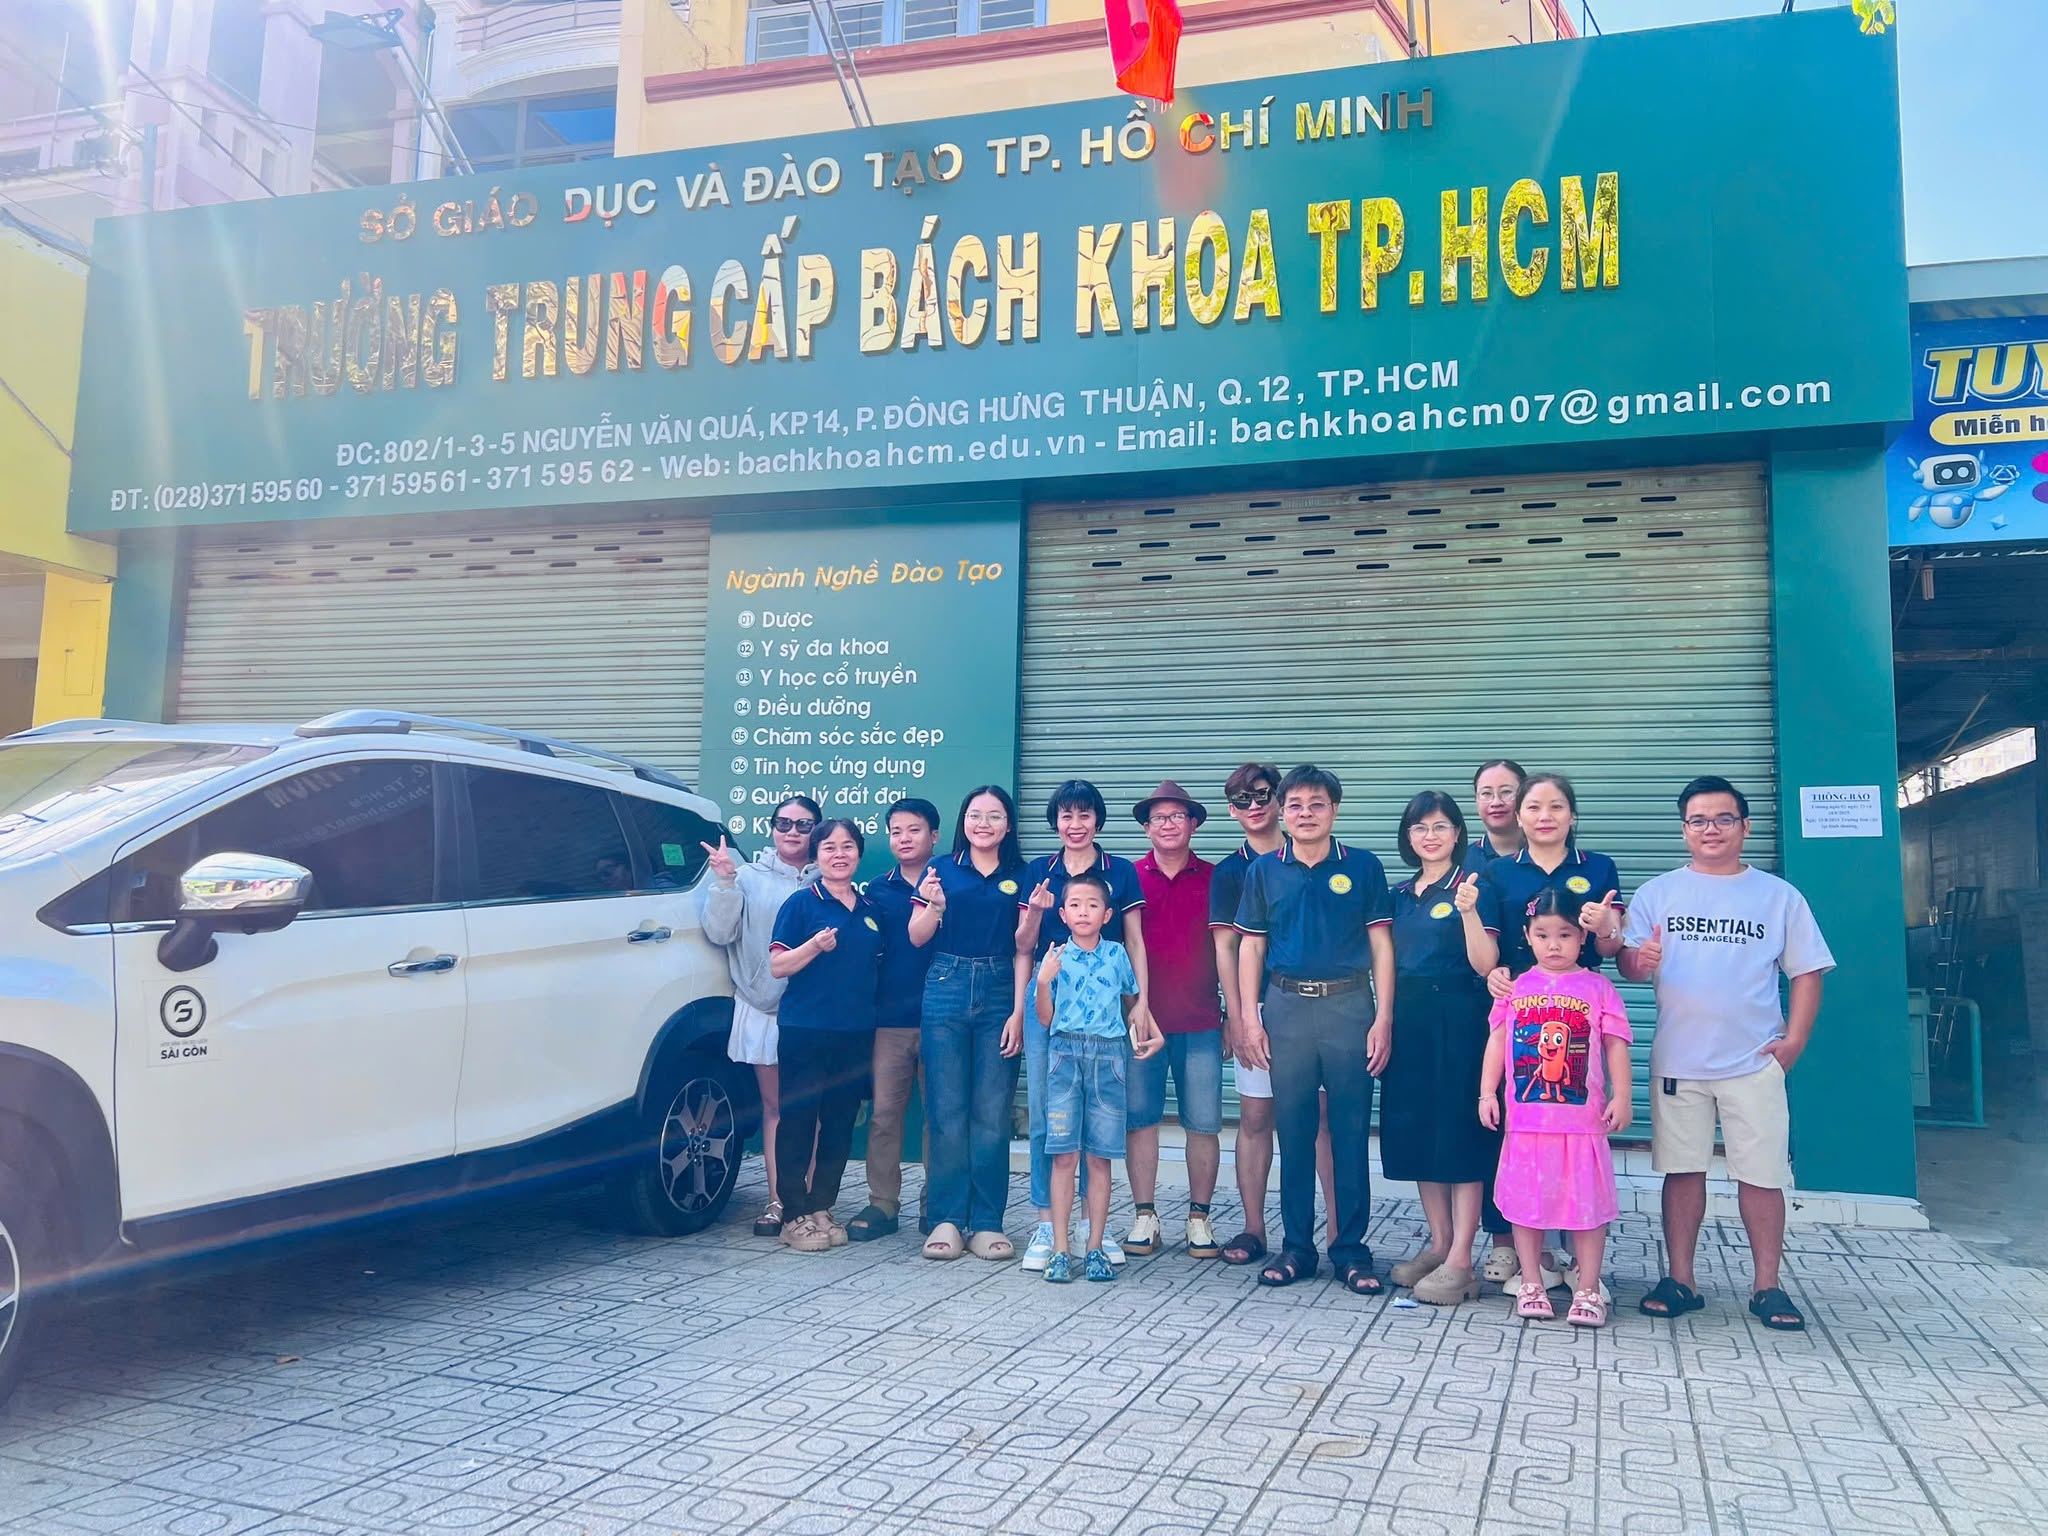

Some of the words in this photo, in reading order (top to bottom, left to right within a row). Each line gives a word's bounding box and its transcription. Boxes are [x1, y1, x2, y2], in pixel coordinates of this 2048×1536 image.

[359, 192, 417, 243] SỞ
[433, 186, 539, 238] GIÁO
[563, 178, 657, 229] DỤC
[675, 161, 730, 209] VÀ
[742, 153, 841, 203] ĐÀO
[864, 141, 964, 195] TẠO
[986, 133, 1061, 175] TP.
[1080, 99, 1156, 166] HỒ
[1178, 94, 1277, 153] CHÍ
[1295, 87, 1433, 142] MINH
[242, 271, 458, 400] TRƯỜNG
[485, 264, 692, 382] TRUNG
[710, 214, 835, 366] CẤP
[859, 214, 1040, 353] BÁCH
[1076, 207, 1282, 335] KHOA
[1307, 171, 1621, 313] TP.HCM
[522, 411, 632, 454] NGUYỄN
[640, 412, 693, 446] VĂN
[979, 390, 1066, 424] HƯNG
[1080, 378, 1206, 418] THUẬN,
[1317, 359, 1459, 398] TP.HCM
[660, 452, 730, 480] Web:
[1117, 420, 1217, 451] Email:
[1231, 379, 1832, 444] bachkhoahcm07@gmail.com
[1954, 413, 2021, 437] Miễn
[726, 567, 807, 594] Ngành
[814, 558, 880, 592] Nghề
[890, 559, 945, 584] Đào
[957, 559, 1003, 586] Tạo
[762, 611, 814, 632] Dược
[761, 639, 774, 657] Y
[779, 639, 801, 660] sỹ
[806, 639, 832, 657] đa
[840, 638, 890, 656] khoa
[760, 669, 773, 686] Y
[779, 669, 817, 690] học
[822, 661, 849, 686] cổ
[855, 662, 918, 688] truyền
[758, 694, 801, 715] Điều
[807, 695, 871, 719] dưỡng
[753, 727, 812, 745] Chăm
[819, 725, 855, 745] sóc
[860, 722, 897, 745] sắc
[903, 726, 944, 747] đẹp
[754, 757, 779, 775] Tin
[785, 757, 823, 779] học
[829, 755, 868, 779] ứng
[874, 756, 926, 779] dụng
[812, 784, 829, 808] lý
[835, 783, 869, 805] đất
[1667, 916, 1765, 940] ESSENTIALS
[1702, 935, 1747, 945] ANGELES
[1512, 994, 1549, 1012] TUNG
[1551, 994, 1591, 1015] TUNG
